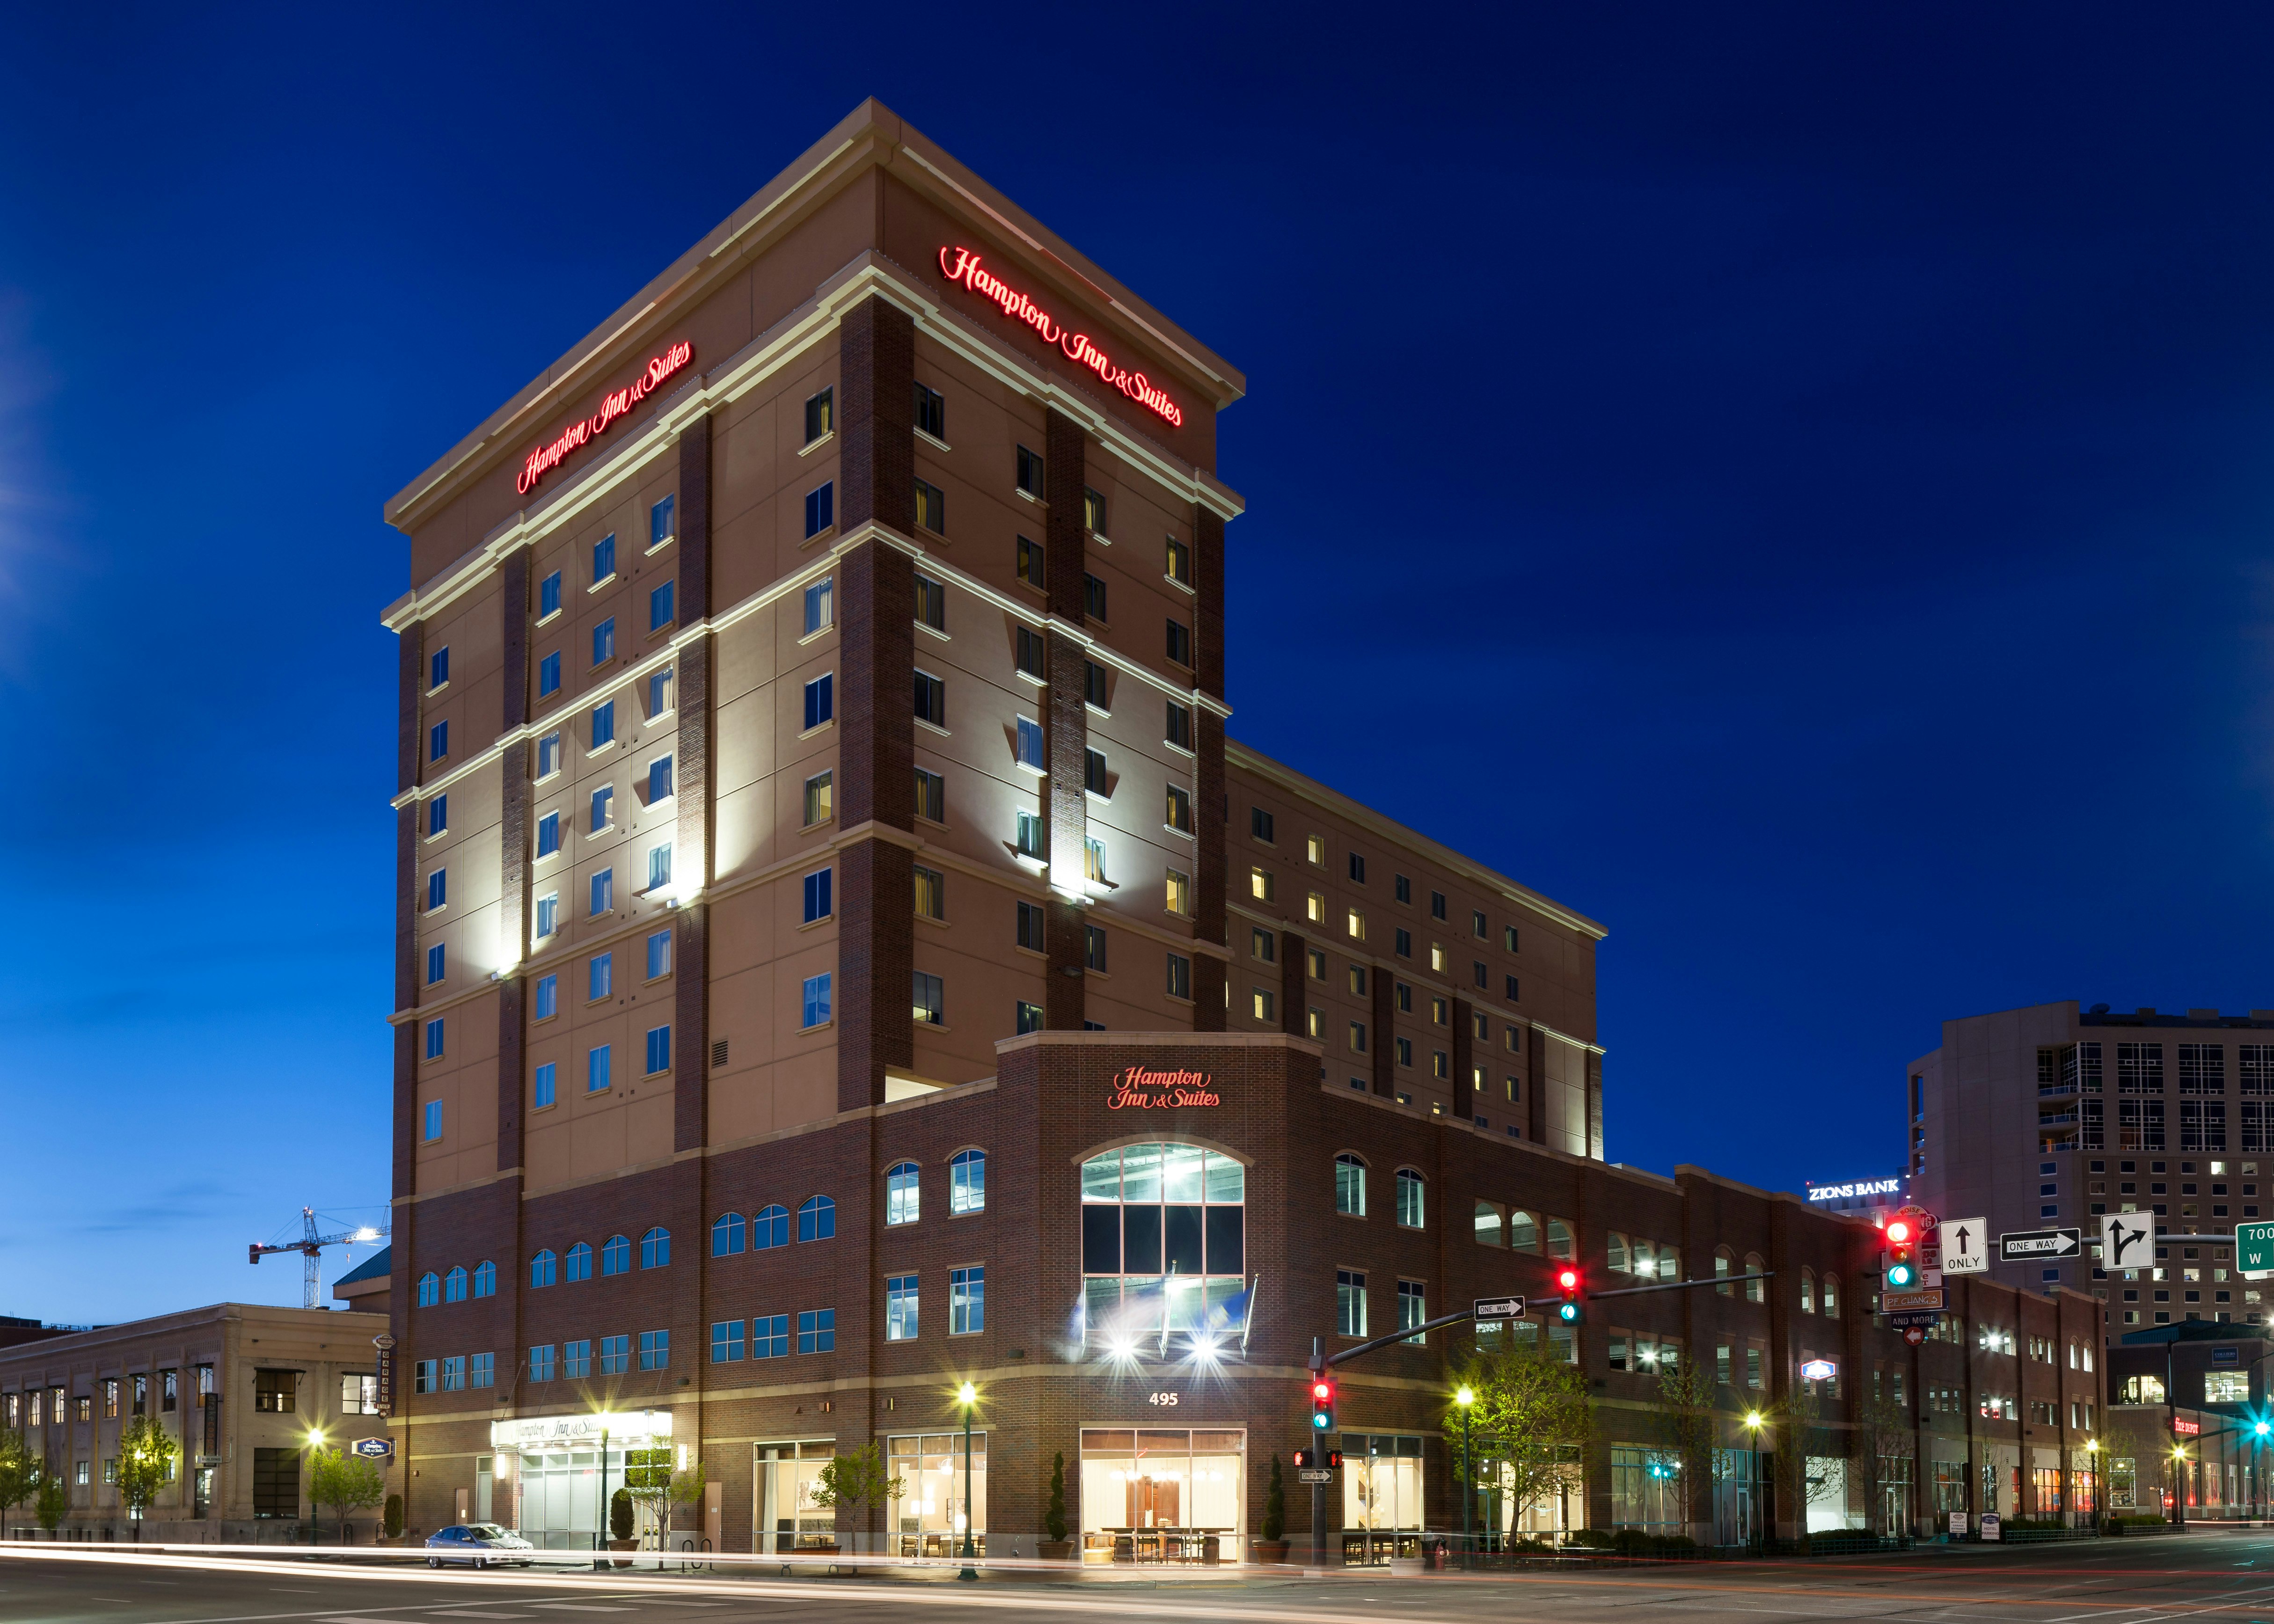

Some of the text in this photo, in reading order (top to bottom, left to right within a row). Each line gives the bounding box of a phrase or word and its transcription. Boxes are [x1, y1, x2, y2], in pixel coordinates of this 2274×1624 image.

[940, 247, 1181, 427] Hampton Inn & Suites
[518, 342, 689, 494] Hampton Inn & Suites
[1114, 1066, 1211, 1090] Hampton
[1107, 1088, 1220, 1109] Inn & Suites
[1809, 1179, 1900, 1201] ZIONS BANK
[1900, 1207, 1921, 1216] BOISE
[2248, 1227, 2274, 1240] 700
[2009, 1239, 2056, 1251] ONE WAY
[1948, 1257, 1980, 1269] ONLY
[2249, 1253, 2261, 1264] W
[1901, 1295, 1938, 1304] CHANG'S
[1149, 1392, 1178, 1406] 495
[511, 1421, 548, 1441] Hampton
[549, 1420, 573, 1437] Inn
